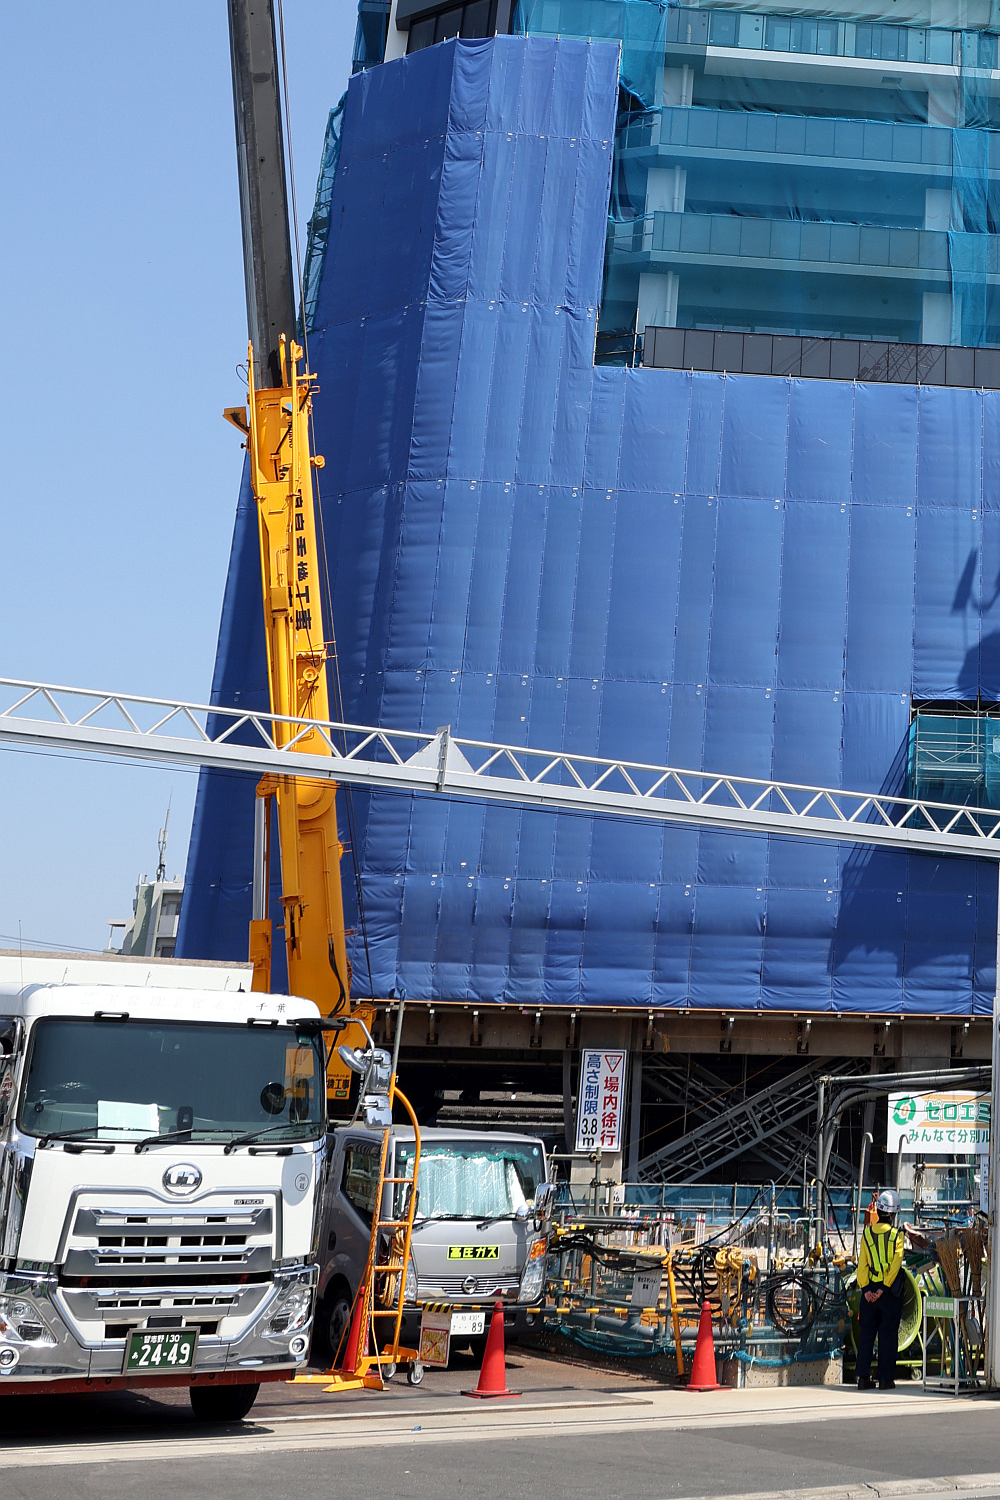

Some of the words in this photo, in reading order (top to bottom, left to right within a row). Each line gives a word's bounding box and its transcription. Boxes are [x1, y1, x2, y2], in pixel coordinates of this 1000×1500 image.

[256, 1002, 288, 1014] 千葉
[584, 1053, 601, 1115] 高さ制限
[600, 1076, 620, 1146] 場内徐行
[581, 1118, 598, 1135] 3.8
[582, 1137, 595, 1147] m
[167, 1170, 200, 1187] UD
[450, 1247, 497, 1258] 高圧ガス
[471, 1322, 483, 1332] 89
[138, 1343, 191, 1366] 24-49
